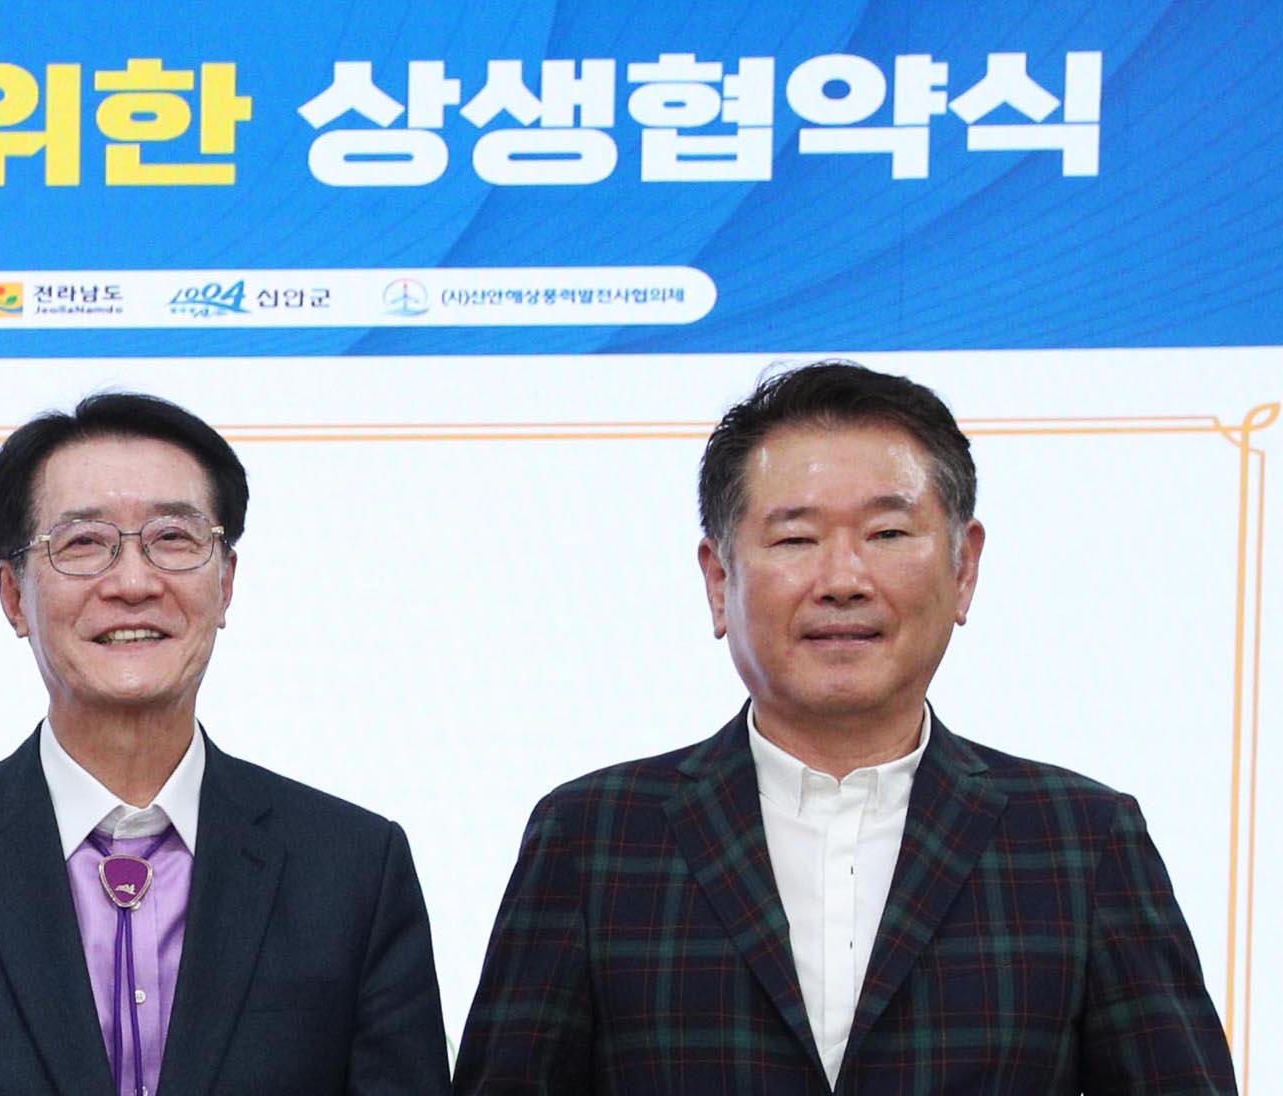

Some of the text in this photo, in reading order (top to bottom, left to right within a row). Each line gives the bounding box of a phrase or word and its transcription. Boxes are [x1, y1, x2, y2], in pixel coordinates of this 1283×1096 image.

[297, 51, 1103, 187] 상생협약식
[35, 284, 123, 303] 전라남도
[256, 288, 332, 309] 신안군
